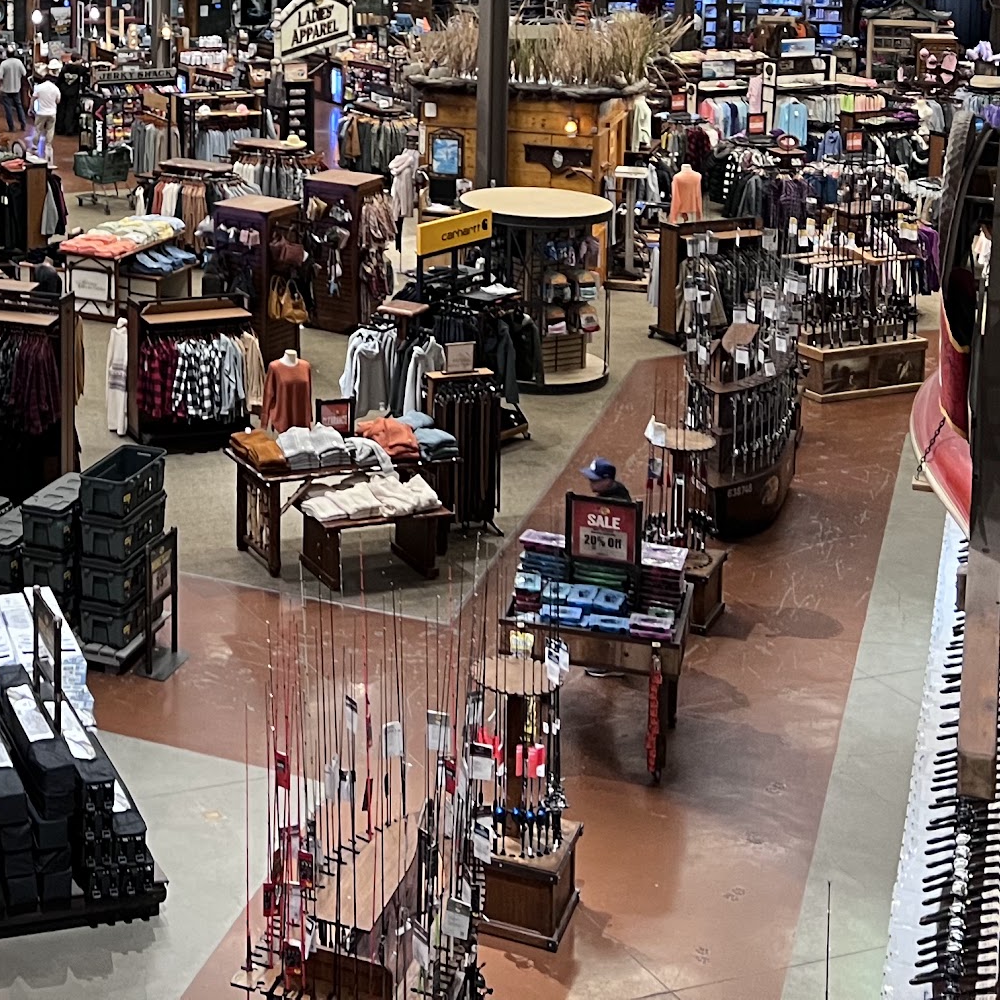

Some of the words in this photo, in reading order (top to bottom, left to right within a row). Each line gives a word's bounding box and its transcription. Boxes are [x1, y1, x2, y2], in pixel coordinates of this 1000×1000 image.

[298, 4, 335, 27] LADIES'
[291, 19, 339, 47] APPAREL
[100, 71, 133, 80] JERKY
[137, 70, 173, 79] SHACK
[441, 223, 481, 241] carhartt
[586, 513, 621, 530] SALE
[584, 534, 606, 547] 20%
